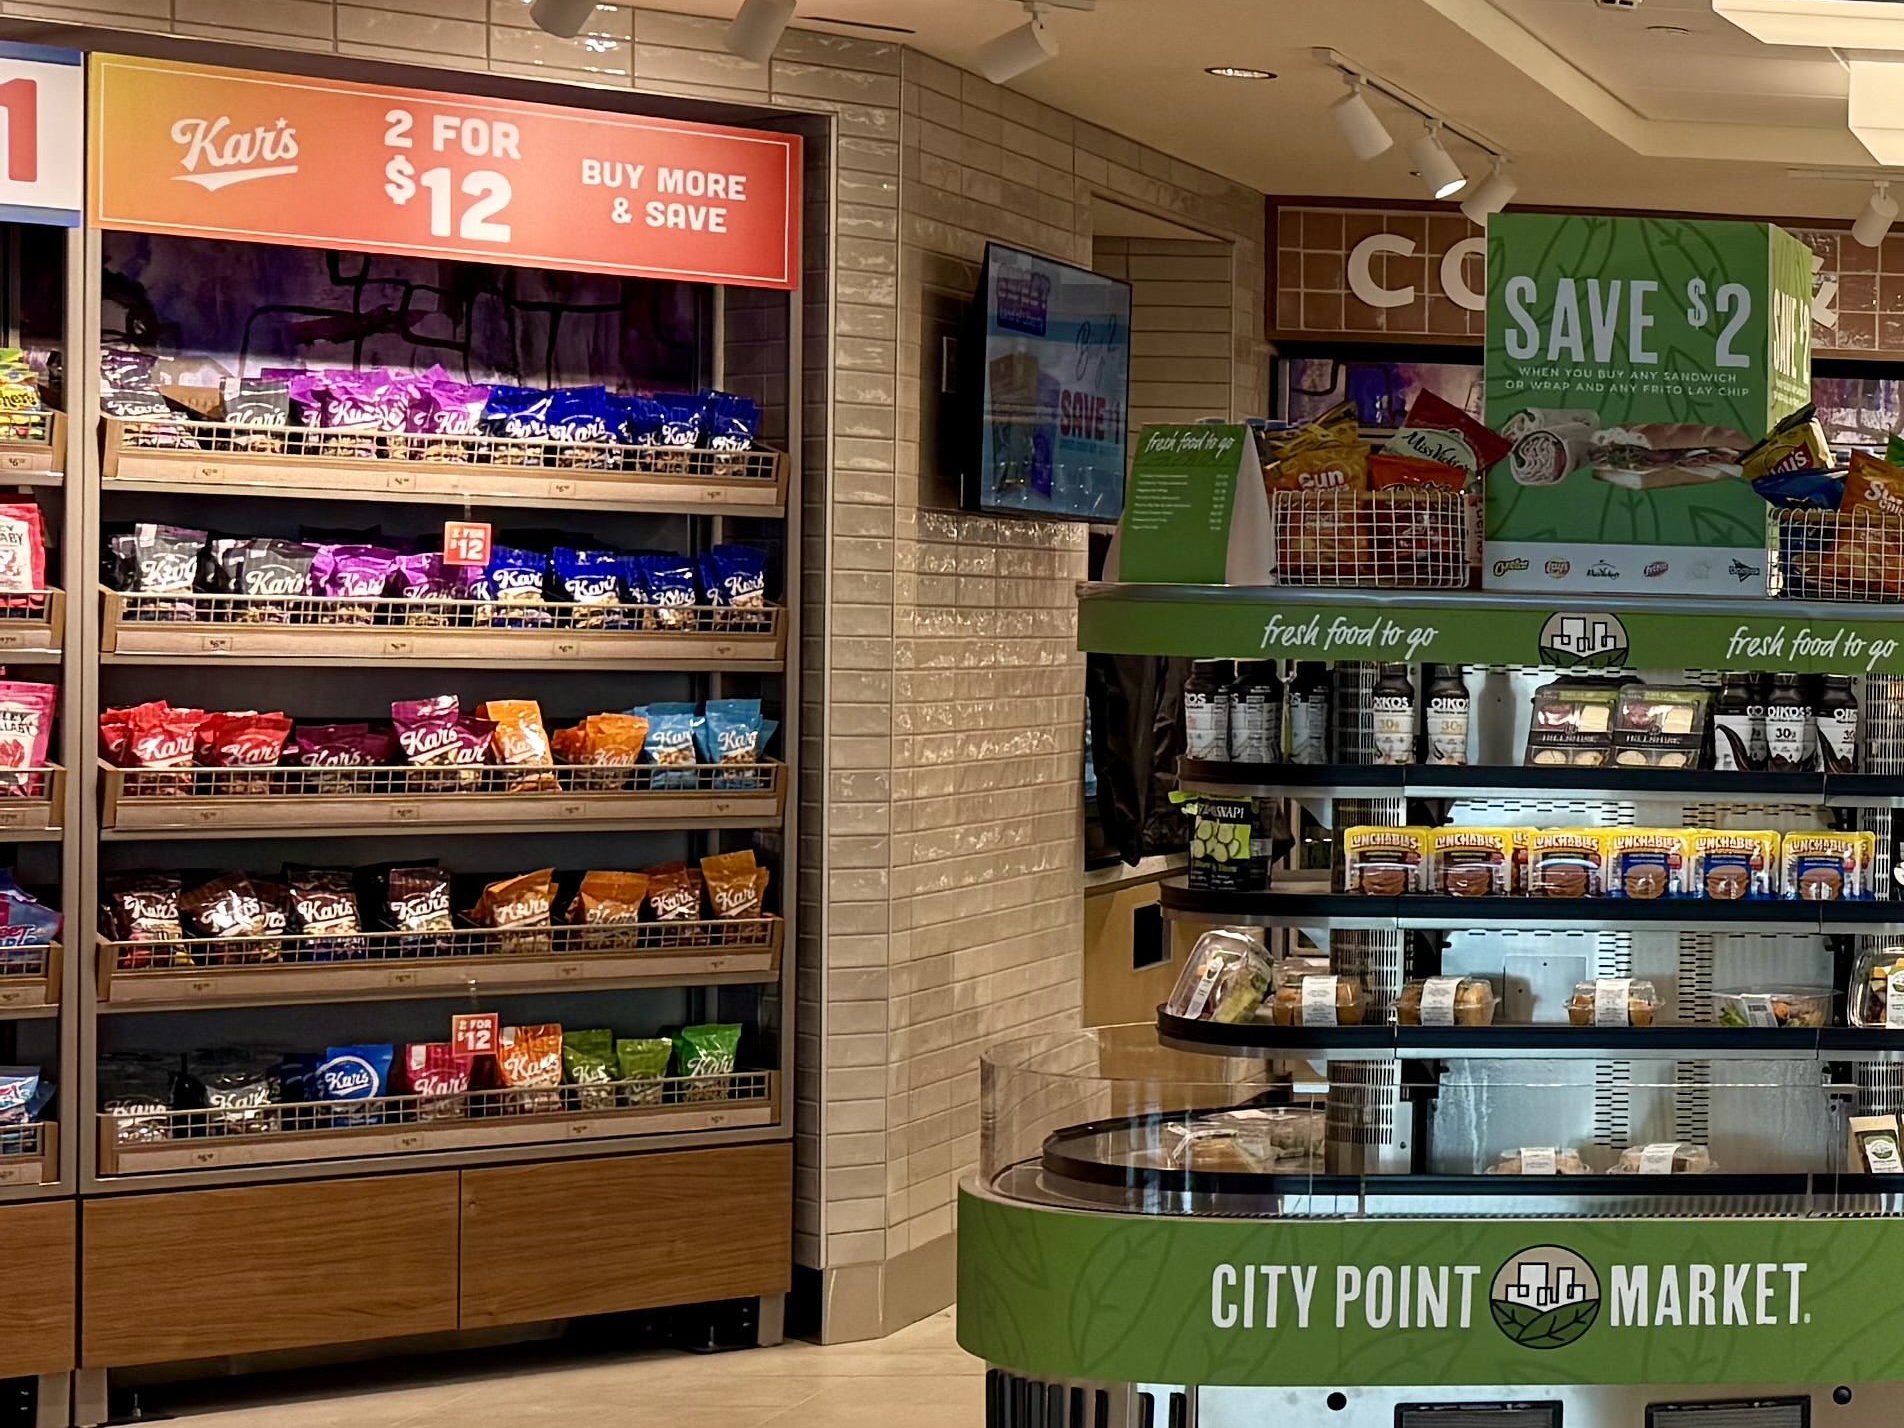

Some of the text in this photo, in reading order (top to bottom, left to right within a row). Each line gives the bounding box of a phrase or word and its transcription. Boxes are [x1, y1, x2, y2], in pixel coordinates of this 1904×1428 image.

[172, 116, 299, 176] Kar's
[384, 109, 520, 161] 2 FOR
[581, 158, 748, 202] BUY MORE
[384, 154, 513, 243] $12
[610, 197, 728, 234] & SAVE
[1504, 275, 1659, 365] SAVE
[1686, 275, 1751, 368] $2
[1505, 380, 1750, 398] OR WRAP AND ANY FRITO LAY CHIP
[1518, 366, 1737, 384] WHEN YOU BUY ANY SANDWICH
[1060, 389, 1106, 441] SAVE
[1145, 431, 1176, 453] fresh
[1177, 431, 1204, 453] food
[1206, 433, 1218, 450] to
[1217, 438, 1235, 459] go
[1401, 430, 1433, 457] Miss
[1260, 613, 1438, 660] fresh food to go
[1727, 626, 1898, 671] fresh food to go
[400, 724, 458, 756] Kar's
[1532, 836, 1600, 851] LUNCHABLES
[1612, 836, 1681, 852] LUNCHABLES
[1694, 836, 1762, 853] LUNCHABLES
[298, 898, 355, 922] Kar's
[458, 1030, 491, 1050] $12
[325, 1069, 369, 1092] Kar's
[1212, 1261, 1809, 1330] CITY POINT MARKET
